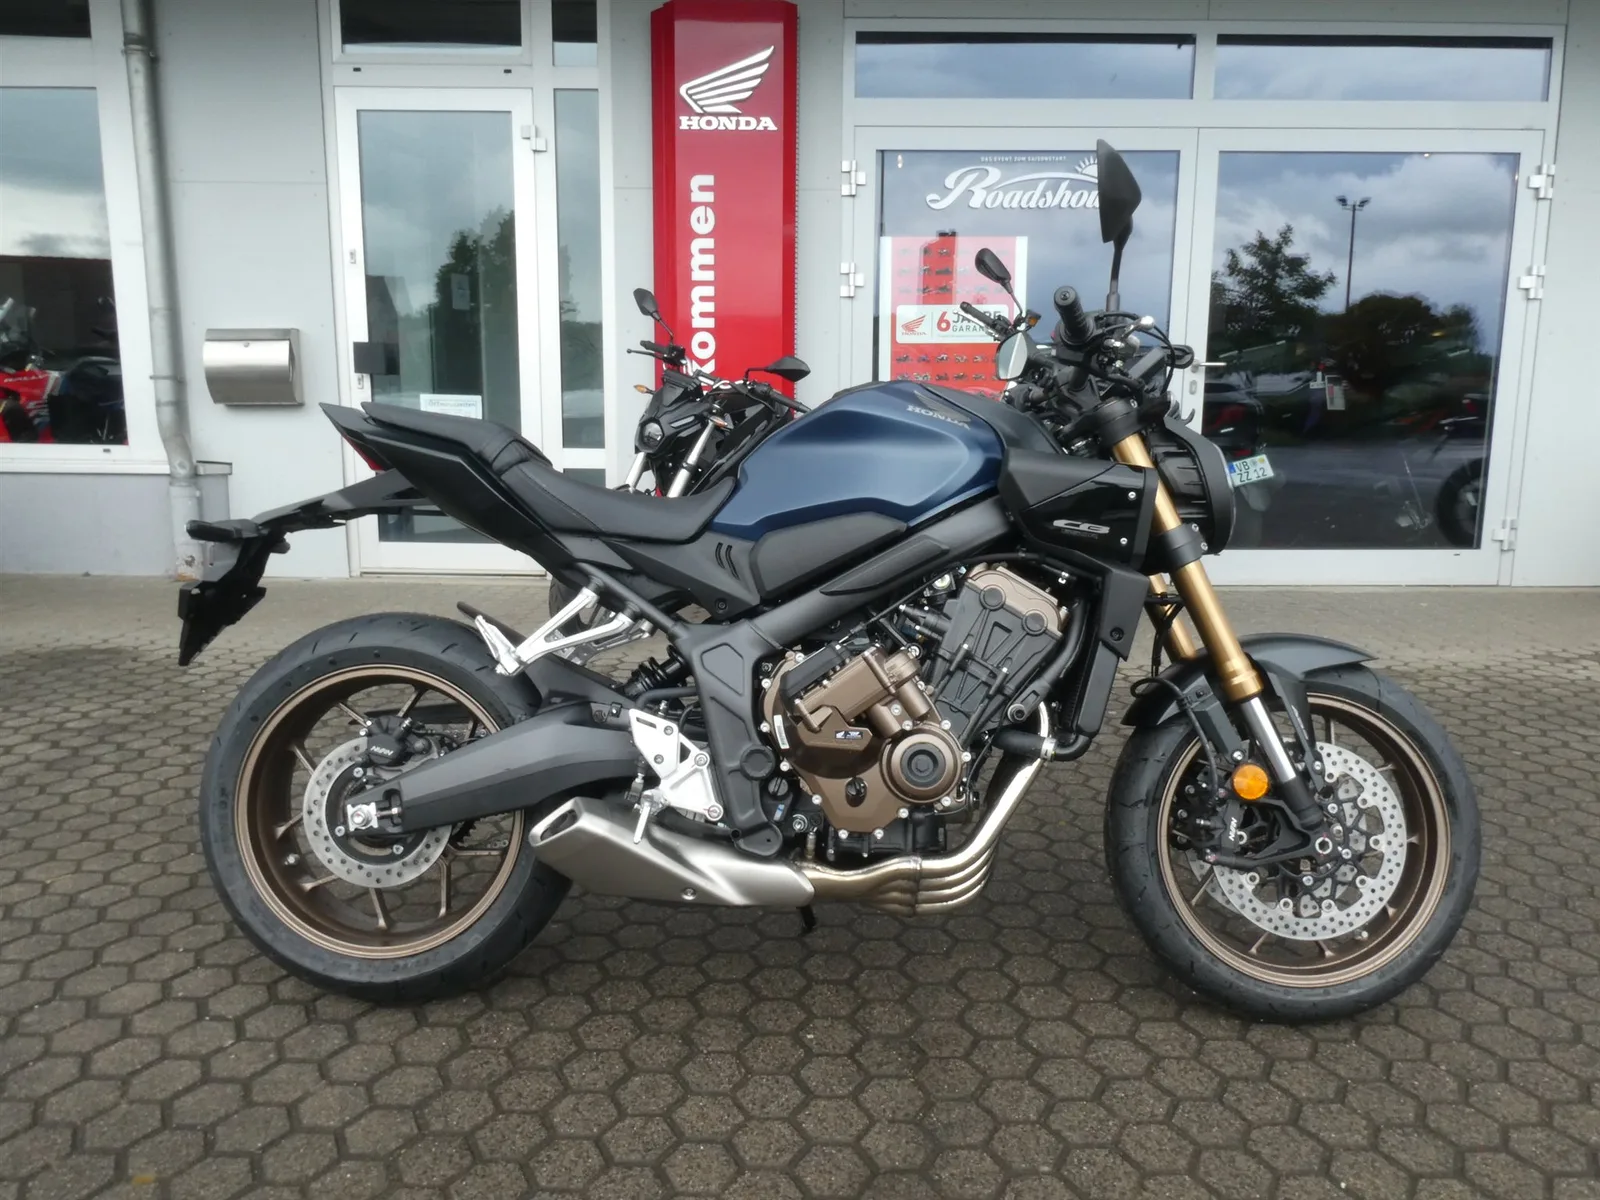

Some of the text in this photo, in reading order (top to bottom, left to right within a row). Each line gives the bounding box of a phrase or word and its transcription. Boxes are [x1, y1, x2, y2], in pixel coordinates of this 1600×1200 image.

[679, 115, 778, 132] HONDA
[690, 174, 717, 374] kommen
[936, 311, 951, 332] 6
[906, 404, 971, 430] HONDA
[1235, 460, 1250, 472] VB
[1237, 467, 1267, 483] ZZ 12
[1052, 519, 1110, 534] CB
